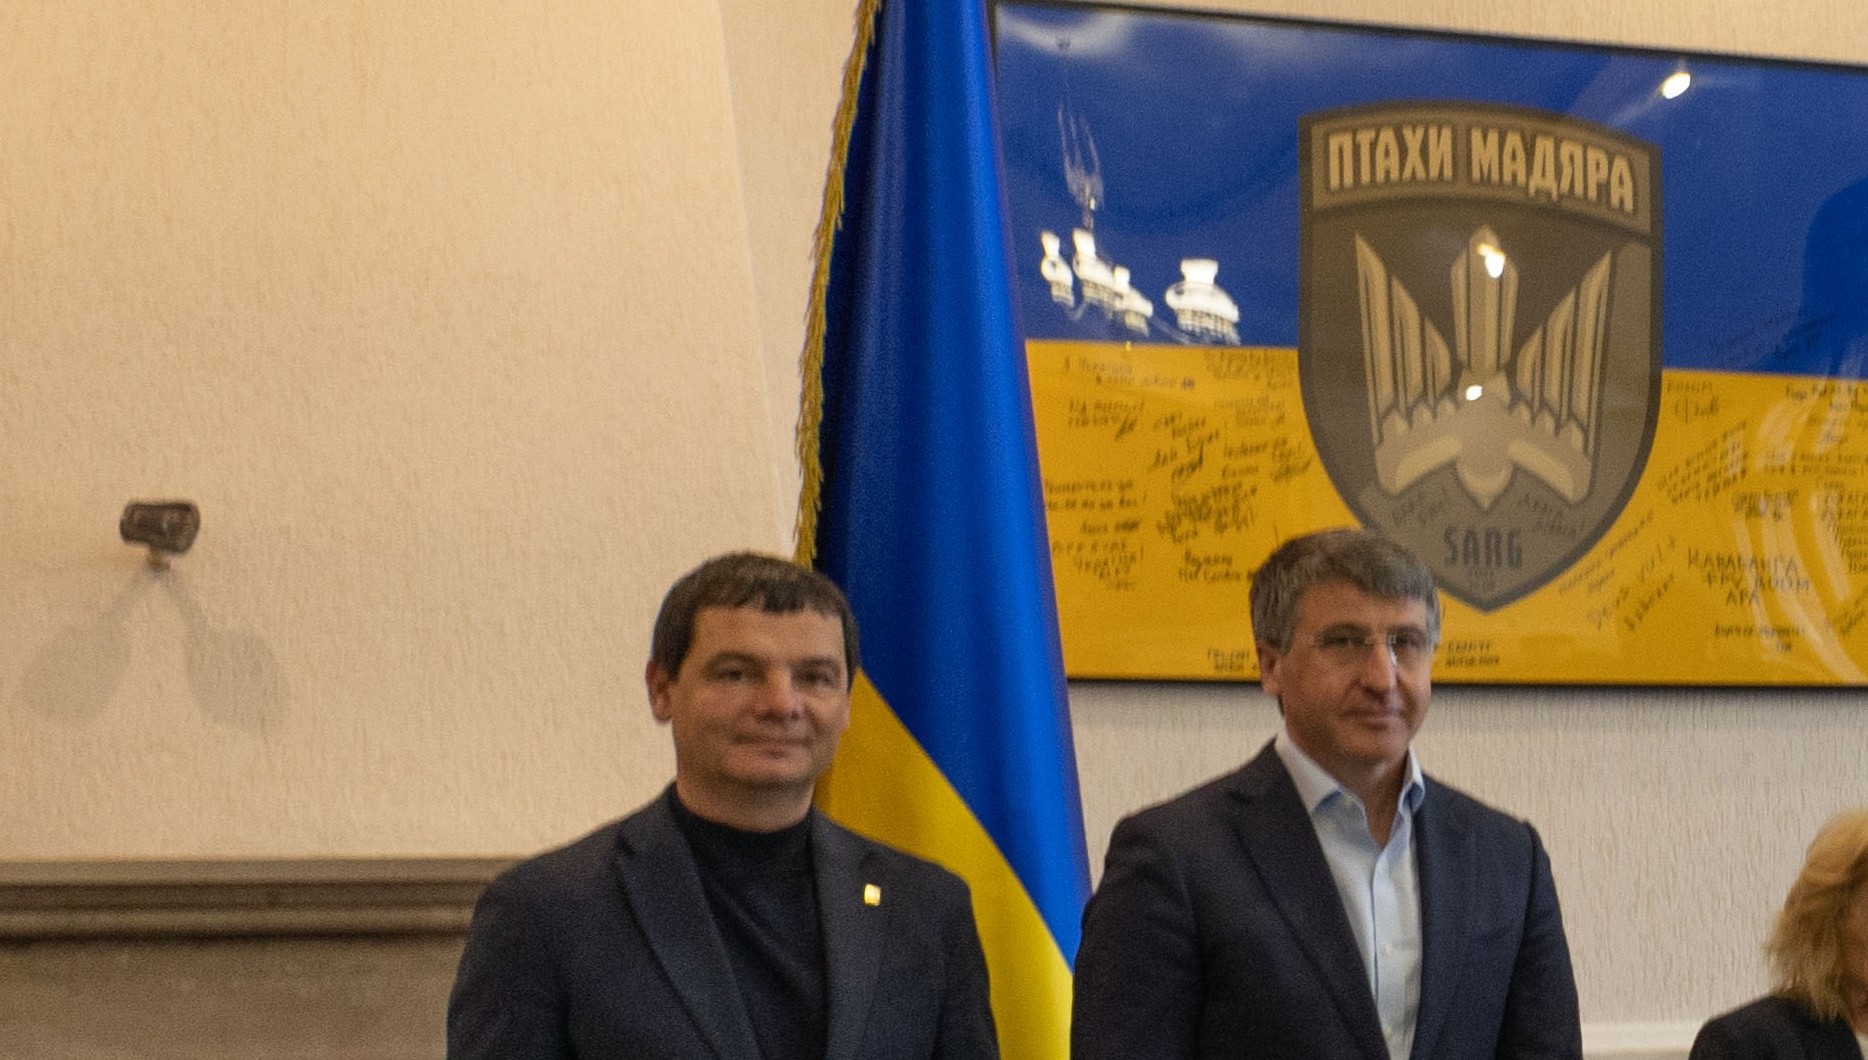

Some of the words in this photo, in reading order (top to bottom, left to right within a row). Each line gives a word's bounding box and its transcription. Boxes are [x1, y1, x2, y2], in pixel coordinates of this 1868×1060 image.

[1328, 124, 1453, 192] ПТАХИ
[1470, 125, 1635, 214] МАДЯРА
[1444, 526, 1523, 569] SARG
